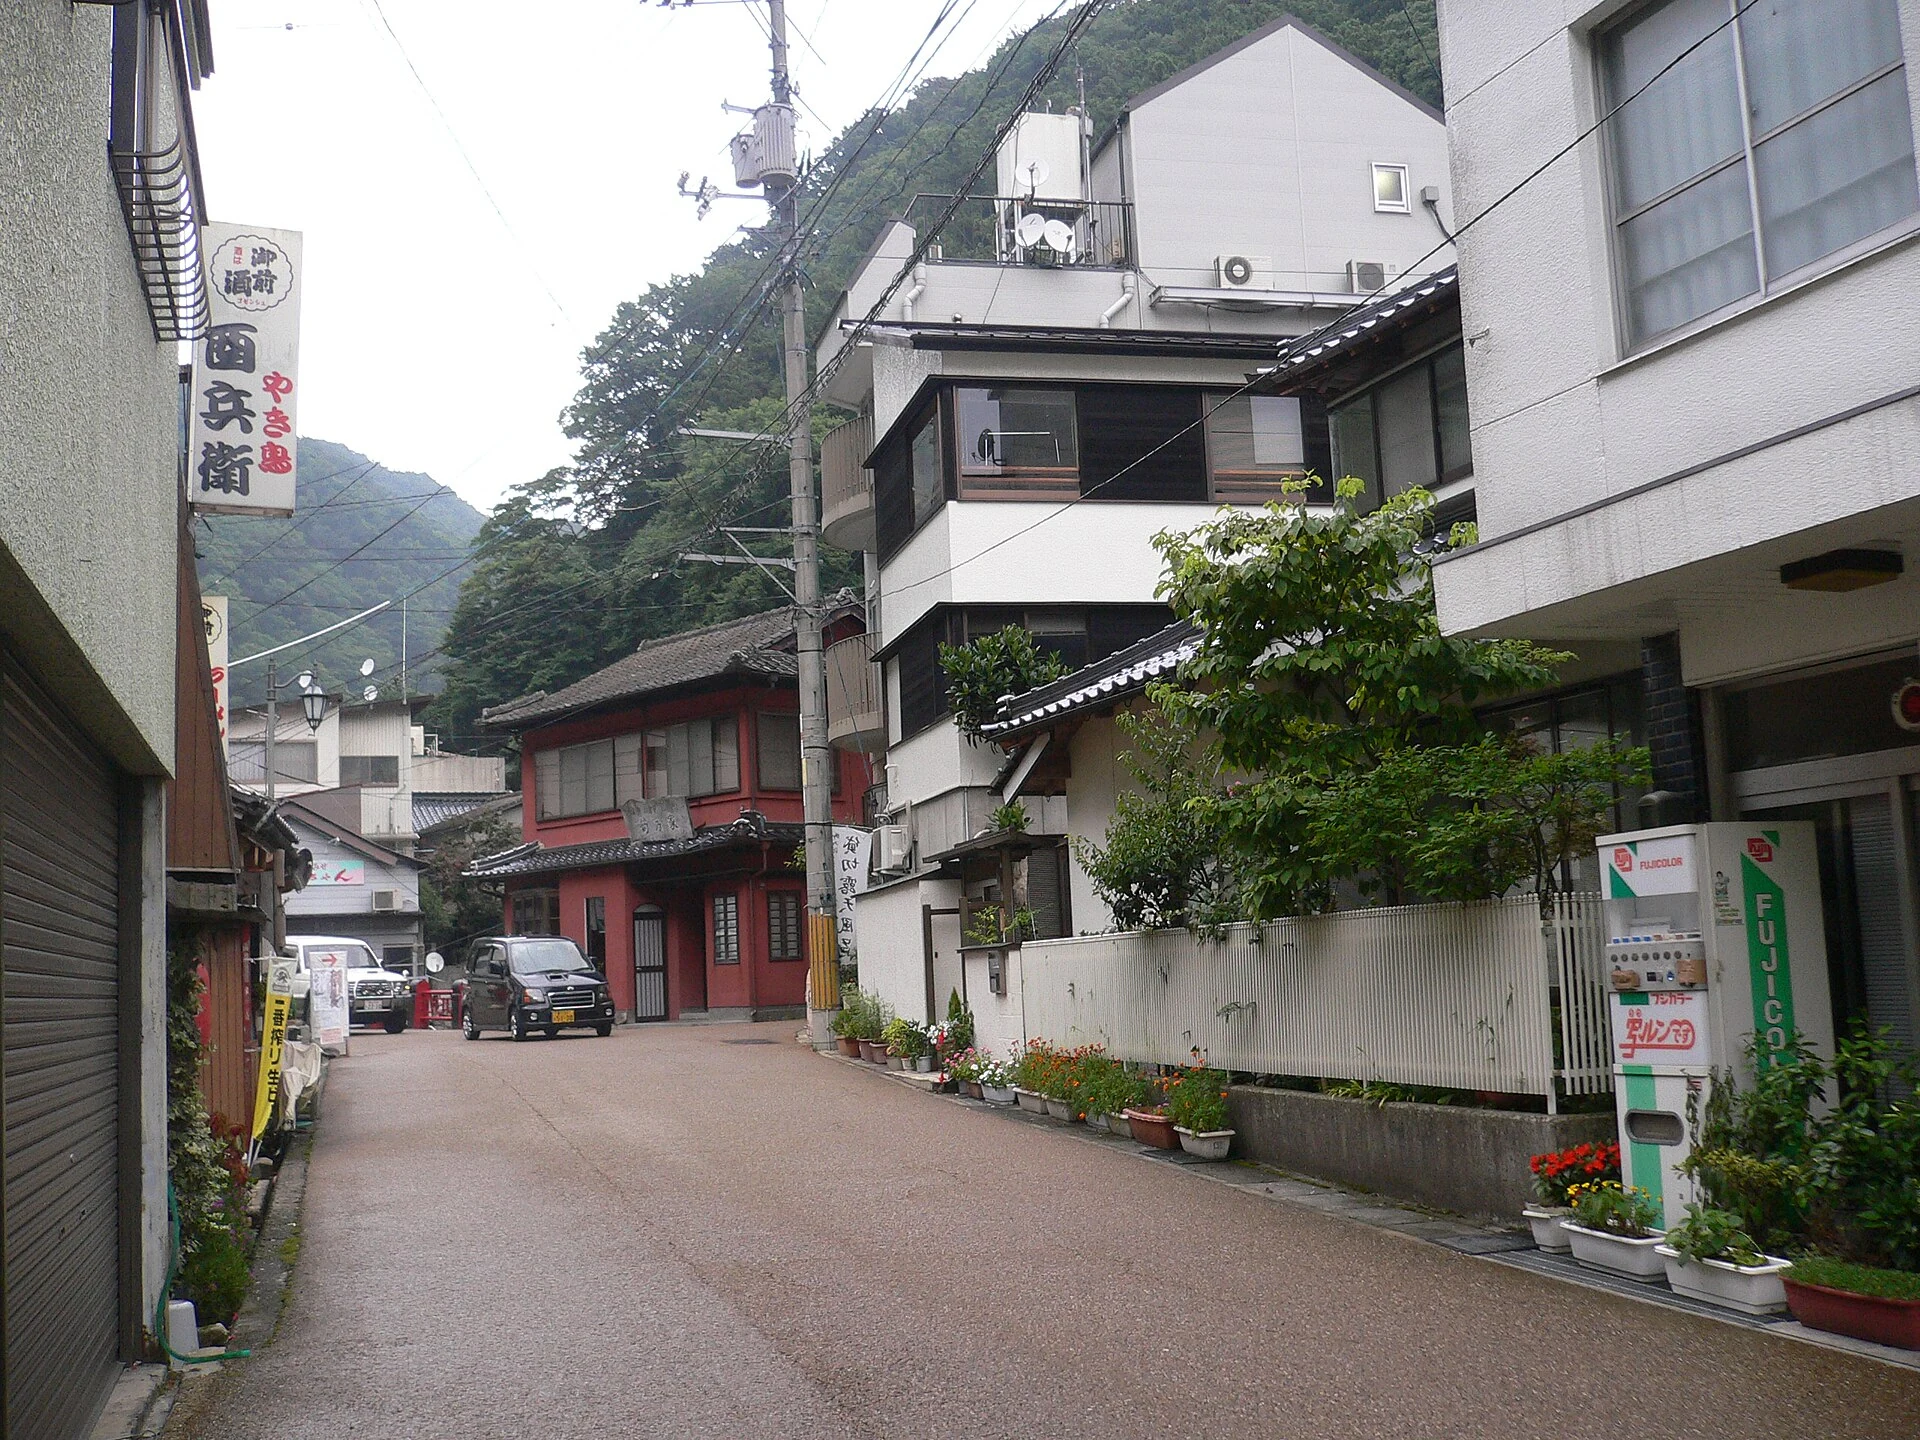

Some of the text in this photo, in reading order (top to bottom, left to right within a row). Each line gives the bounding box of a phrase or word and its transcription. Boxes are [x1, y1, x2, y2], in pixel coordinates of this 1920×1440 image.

[1640, 857, 1684, 870] FUJICOLOR
[1650, 992, 1693, 1005] フジカラー
[1619, 1008, 1696, 1058] 写ルンです
